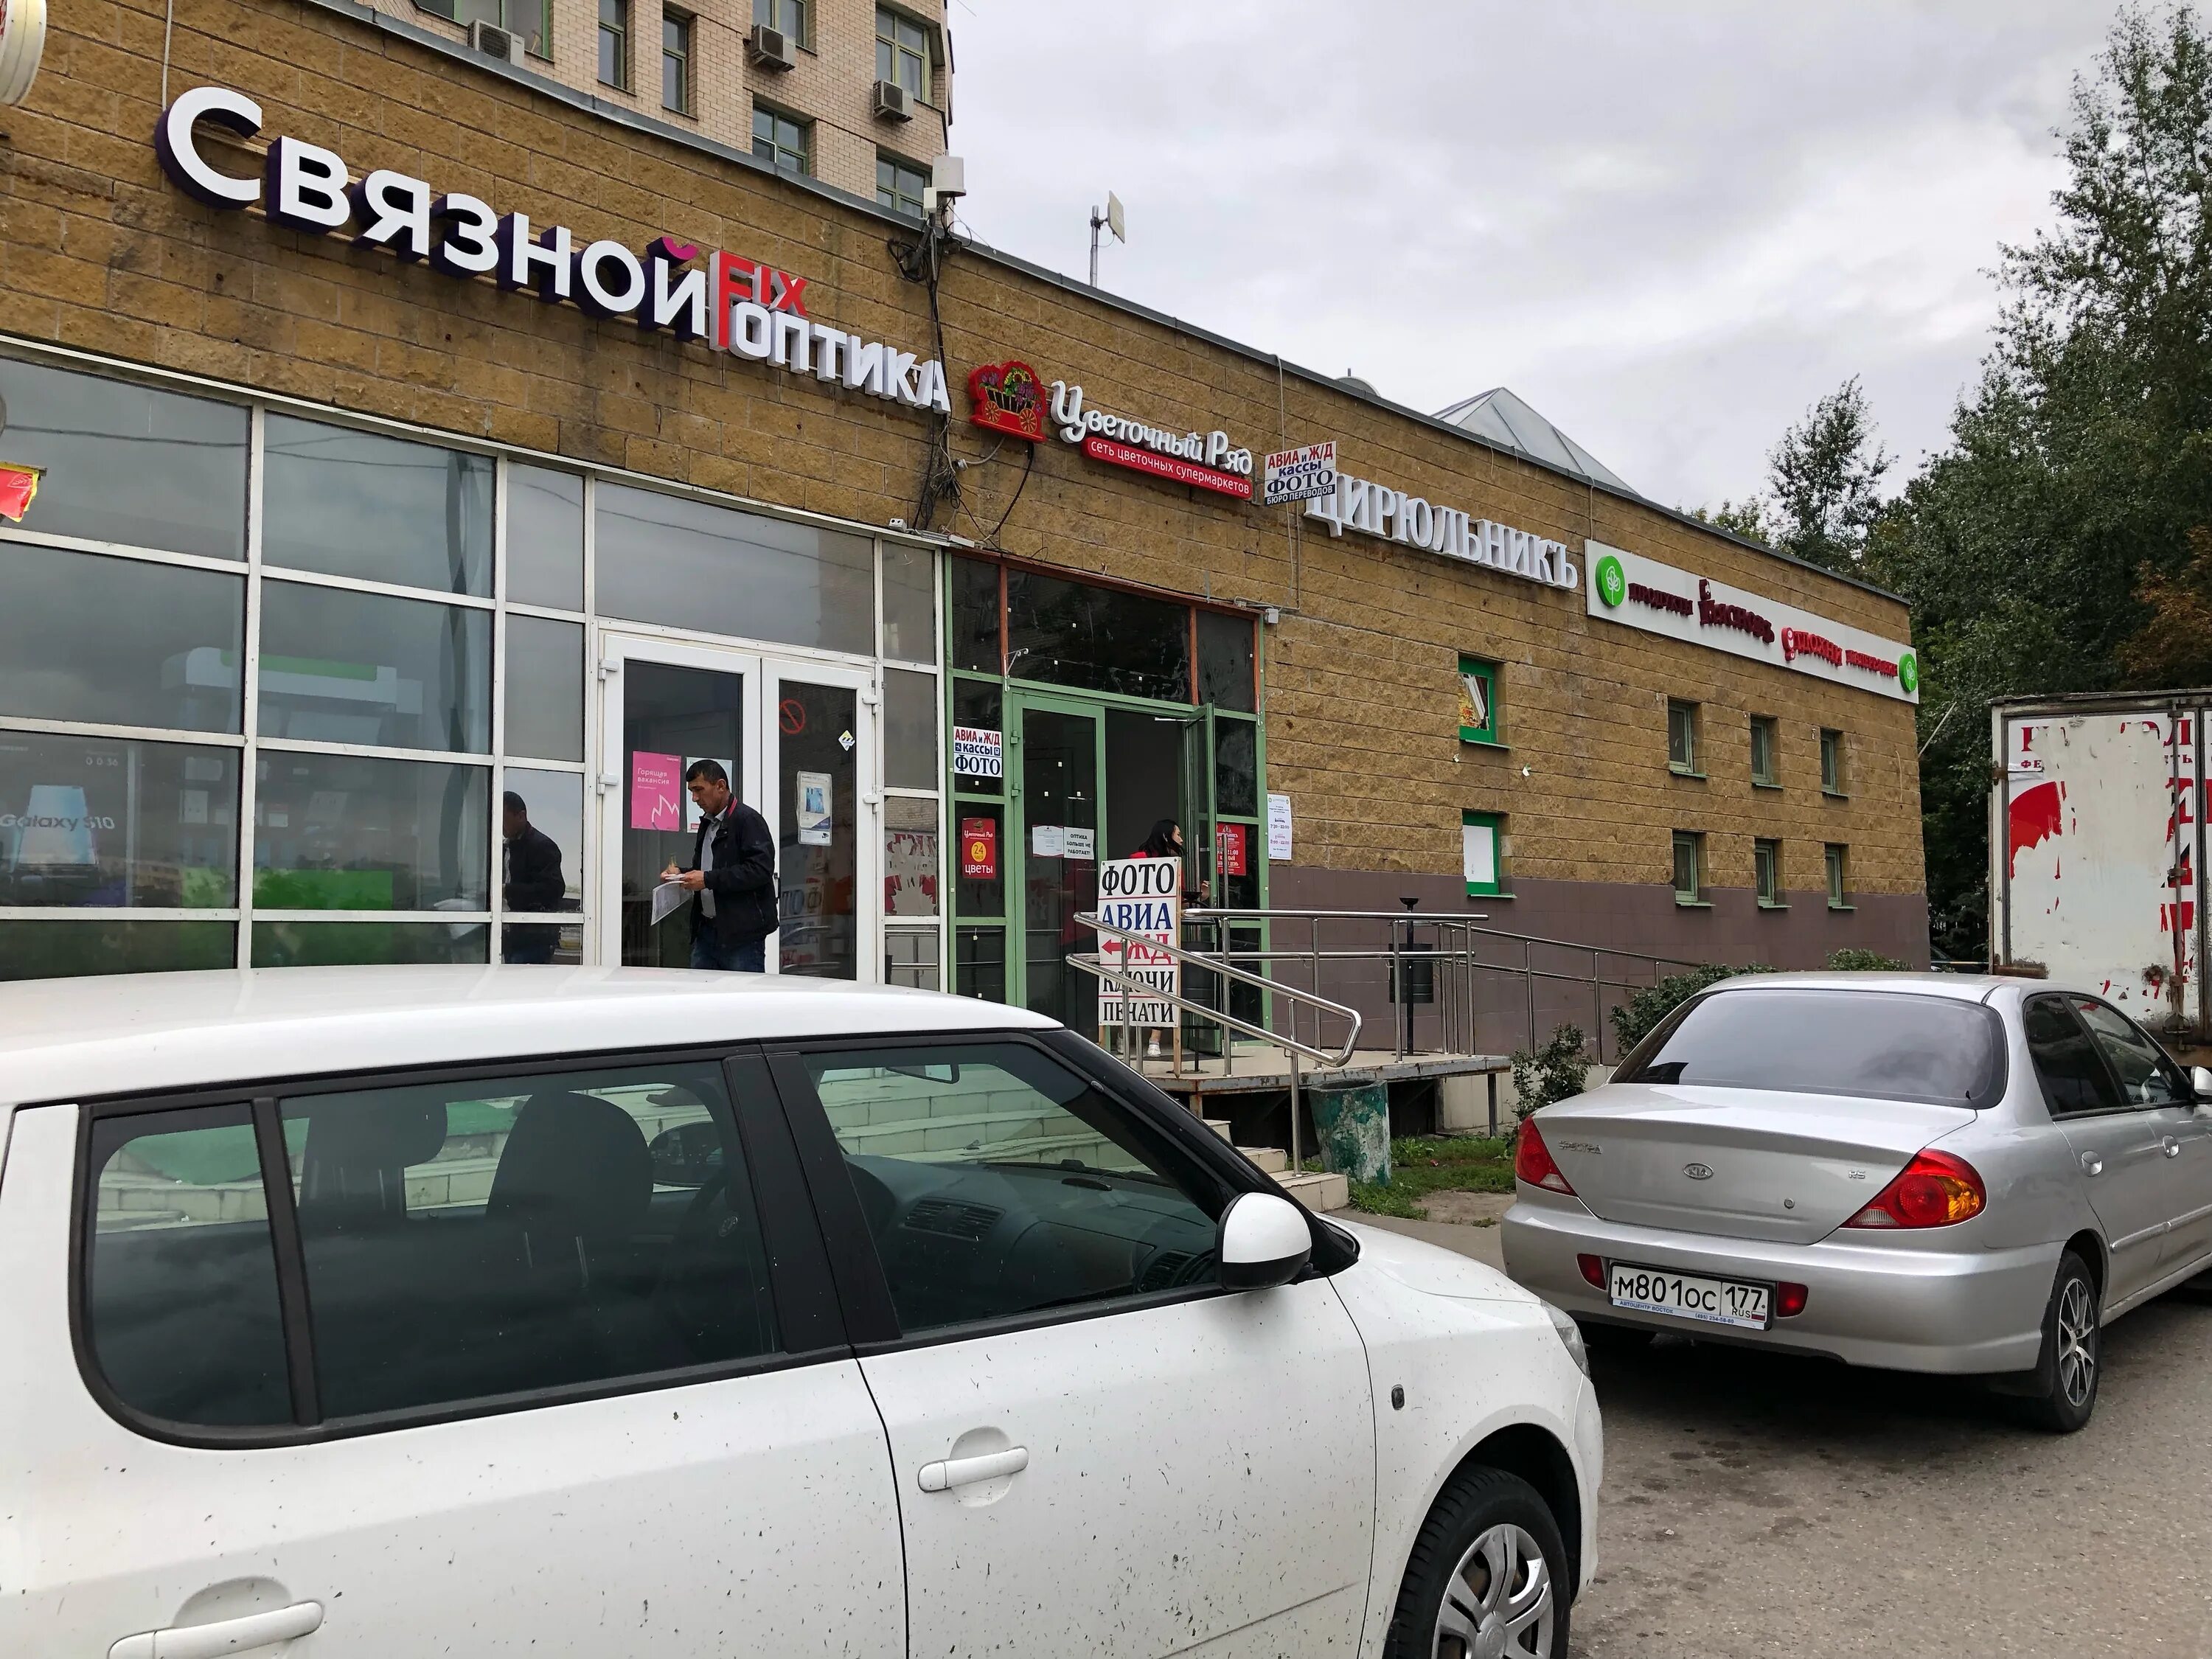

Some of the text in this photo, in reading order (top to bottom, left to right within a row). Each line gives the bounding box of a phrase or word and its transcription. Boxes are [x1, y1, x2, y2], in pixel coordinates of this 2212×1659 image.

[156, 87, 706, 341] Связной
[709, 249, 809, 352] FIX
[730, 301, 951, 414] ОПТИКА
[1050, 380, 1253, 476] Цветочный Ряд
[1091, 439, 1250, 495] сеть цветочных супермаркетов
[1267, 443, 1334, 469] АВИА и Ж/Д
[1279, 459, 1322, 477] кассы
[1267, 469, 1333, 495] ФОТО
[1266, 484, 1335, 506] БЮРО ПЕРЕВОДОВ
[1304, 472, 1578, 589] ЦИРЮЛЬНИКЪ
[955, 728, 977, 743] АВИА
[984, 731, 1001, 746] Ж/Д
[963, 742, 993, 756] кассы
[637, 768, 667, 777] Горящая
[955, 754, 1001, 775] ФОТО
[637, 776, 669, 785] вакансия
[0, 813, 115, 831] Galaxy S10
[974, 844, 983, 855] 24
[1102, 863, 1175, 896] ФОТО
[1102, 902, 1173, 931] АВИА
[1127, 933, 1172, 964] ЖД
[1103, 1002, 1175, 1023] ПЕЧАТИ
[1687, 1166, 1708, 1177] KIA
[1619, 1301, 1651, 1310] АВТОЦЕНТР
[1652, 1306, 1674, 1314] ВОСТОК
[1725, 1287, 1762, 1310] 177
[1732, 1308, 1750, 1318] RUS
